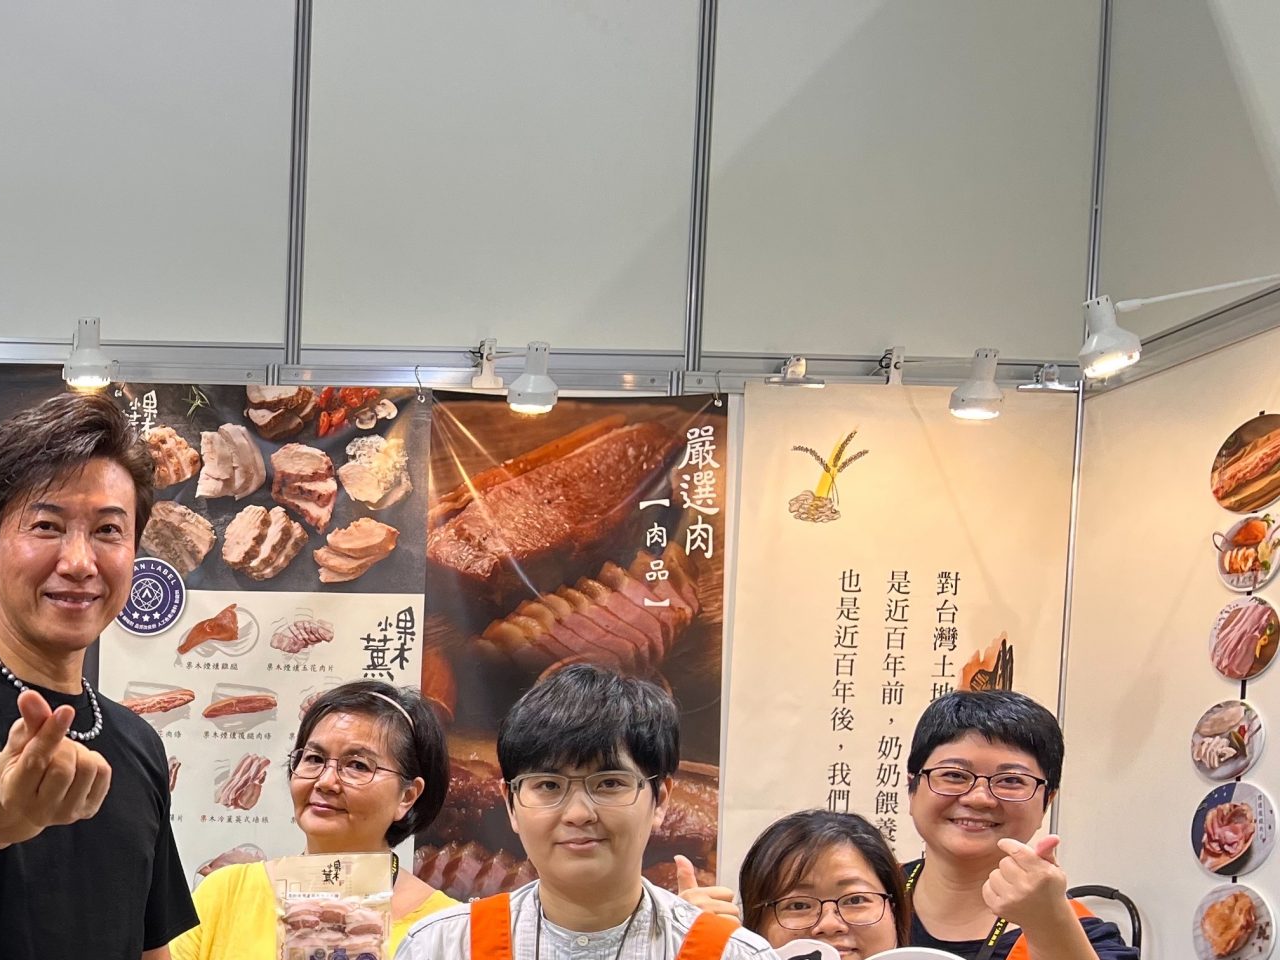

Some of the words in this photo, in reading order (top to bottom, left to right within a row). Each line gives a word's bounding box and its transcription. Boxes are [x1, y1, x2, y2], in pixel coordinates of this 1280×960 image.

[678, 425, 720, 559] 嚴選肉
[151, 563, 177, 586] LABEL
